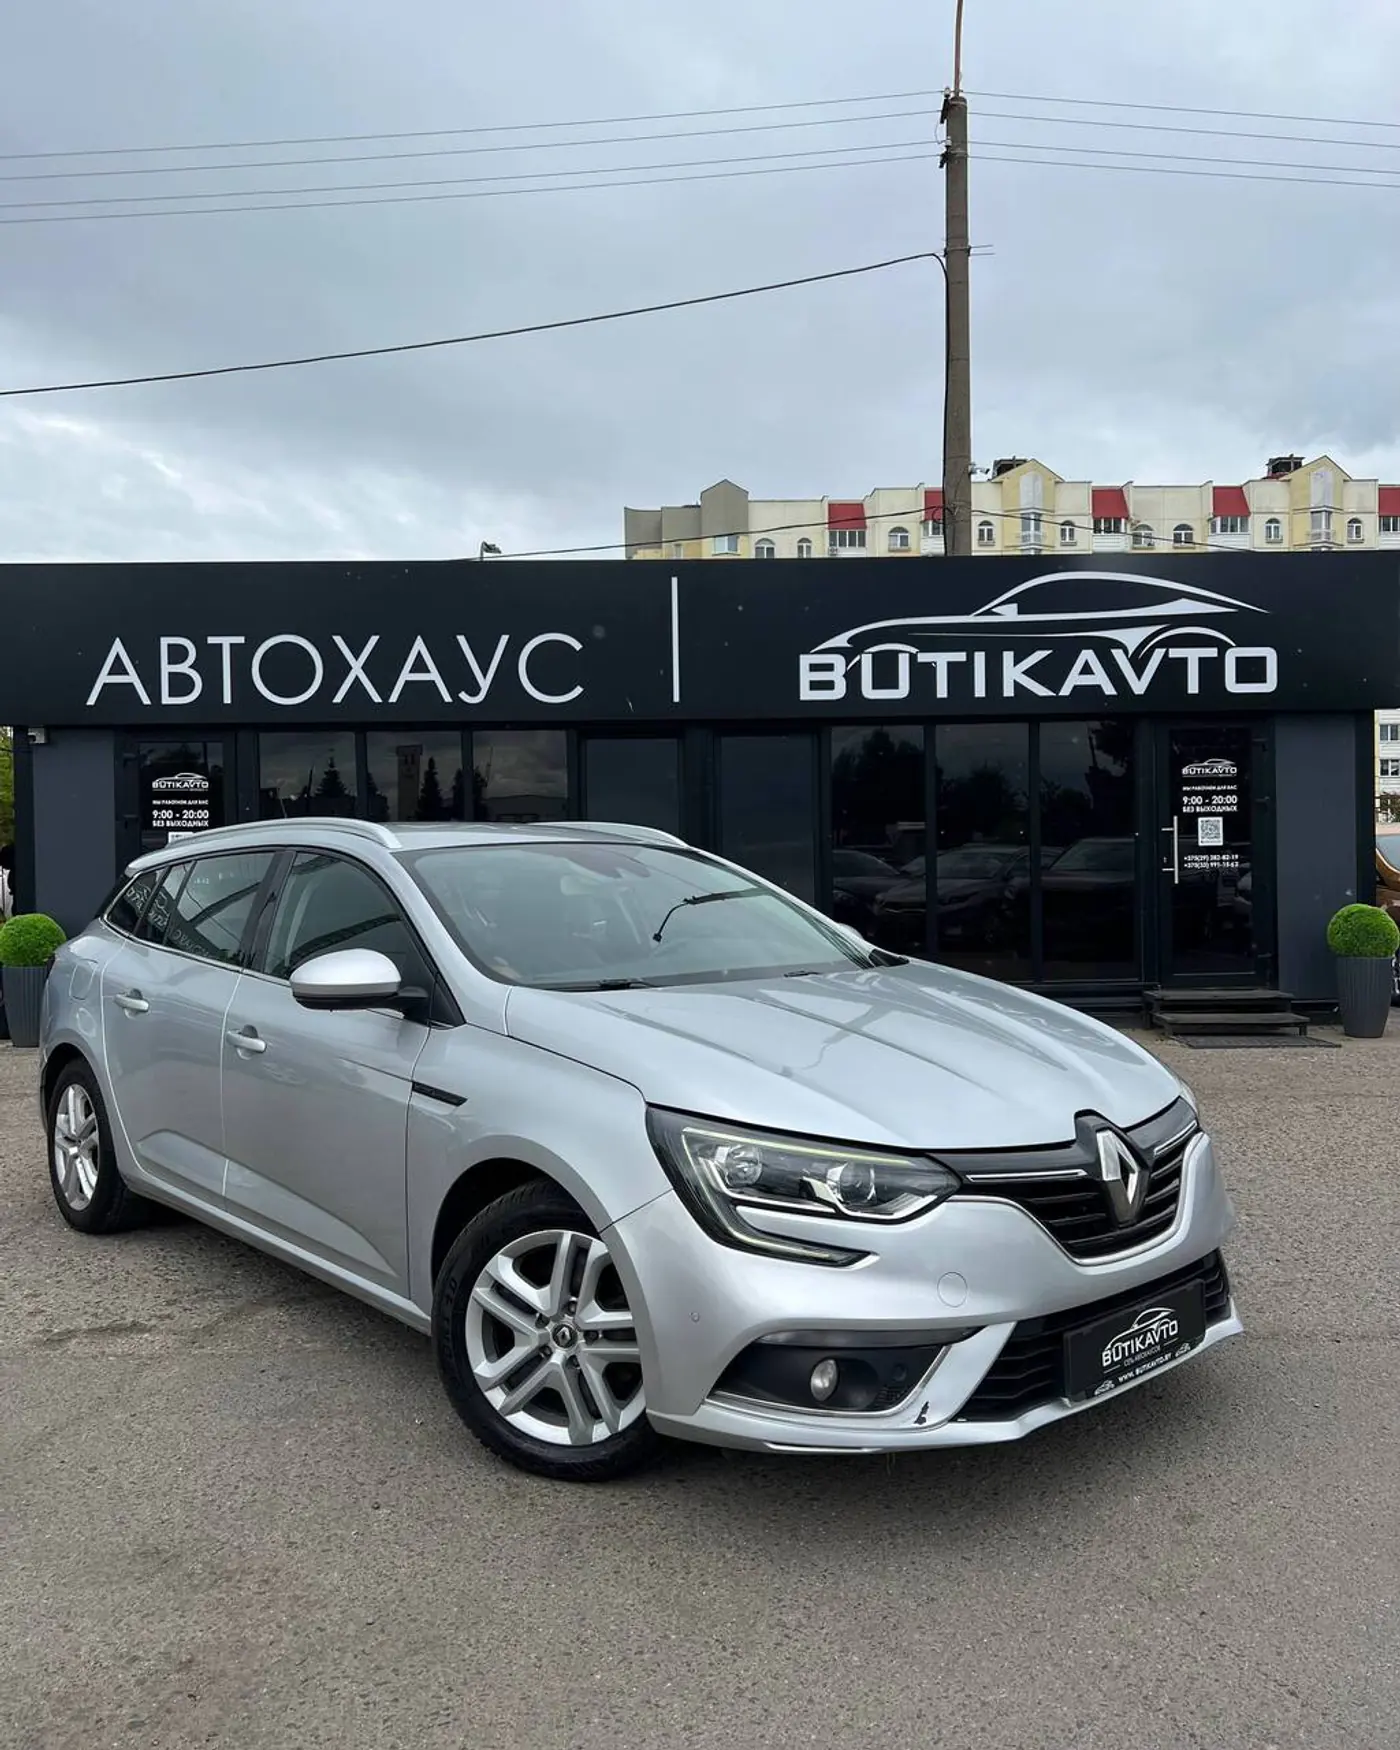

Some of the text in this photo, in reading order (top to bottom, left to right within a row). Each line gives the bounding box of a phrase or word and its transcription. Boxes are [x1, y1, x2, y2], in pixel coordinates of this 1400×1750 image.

[86, 632, 584, 706] АВТОХАУС
[799, 645, 1278, 701] BUTIKAVTO
[152, 780, 209, 789] BUTIKAVTO
[152, 810, 174, 819] 9:00
[182, 809, 209, 819] 20:00
[1182, 795, 1203, 805] 9:00
[1211, 794, 1238, 804] 20:00
[1102, 1320, 1178, 1367] BUTIKAVTO
